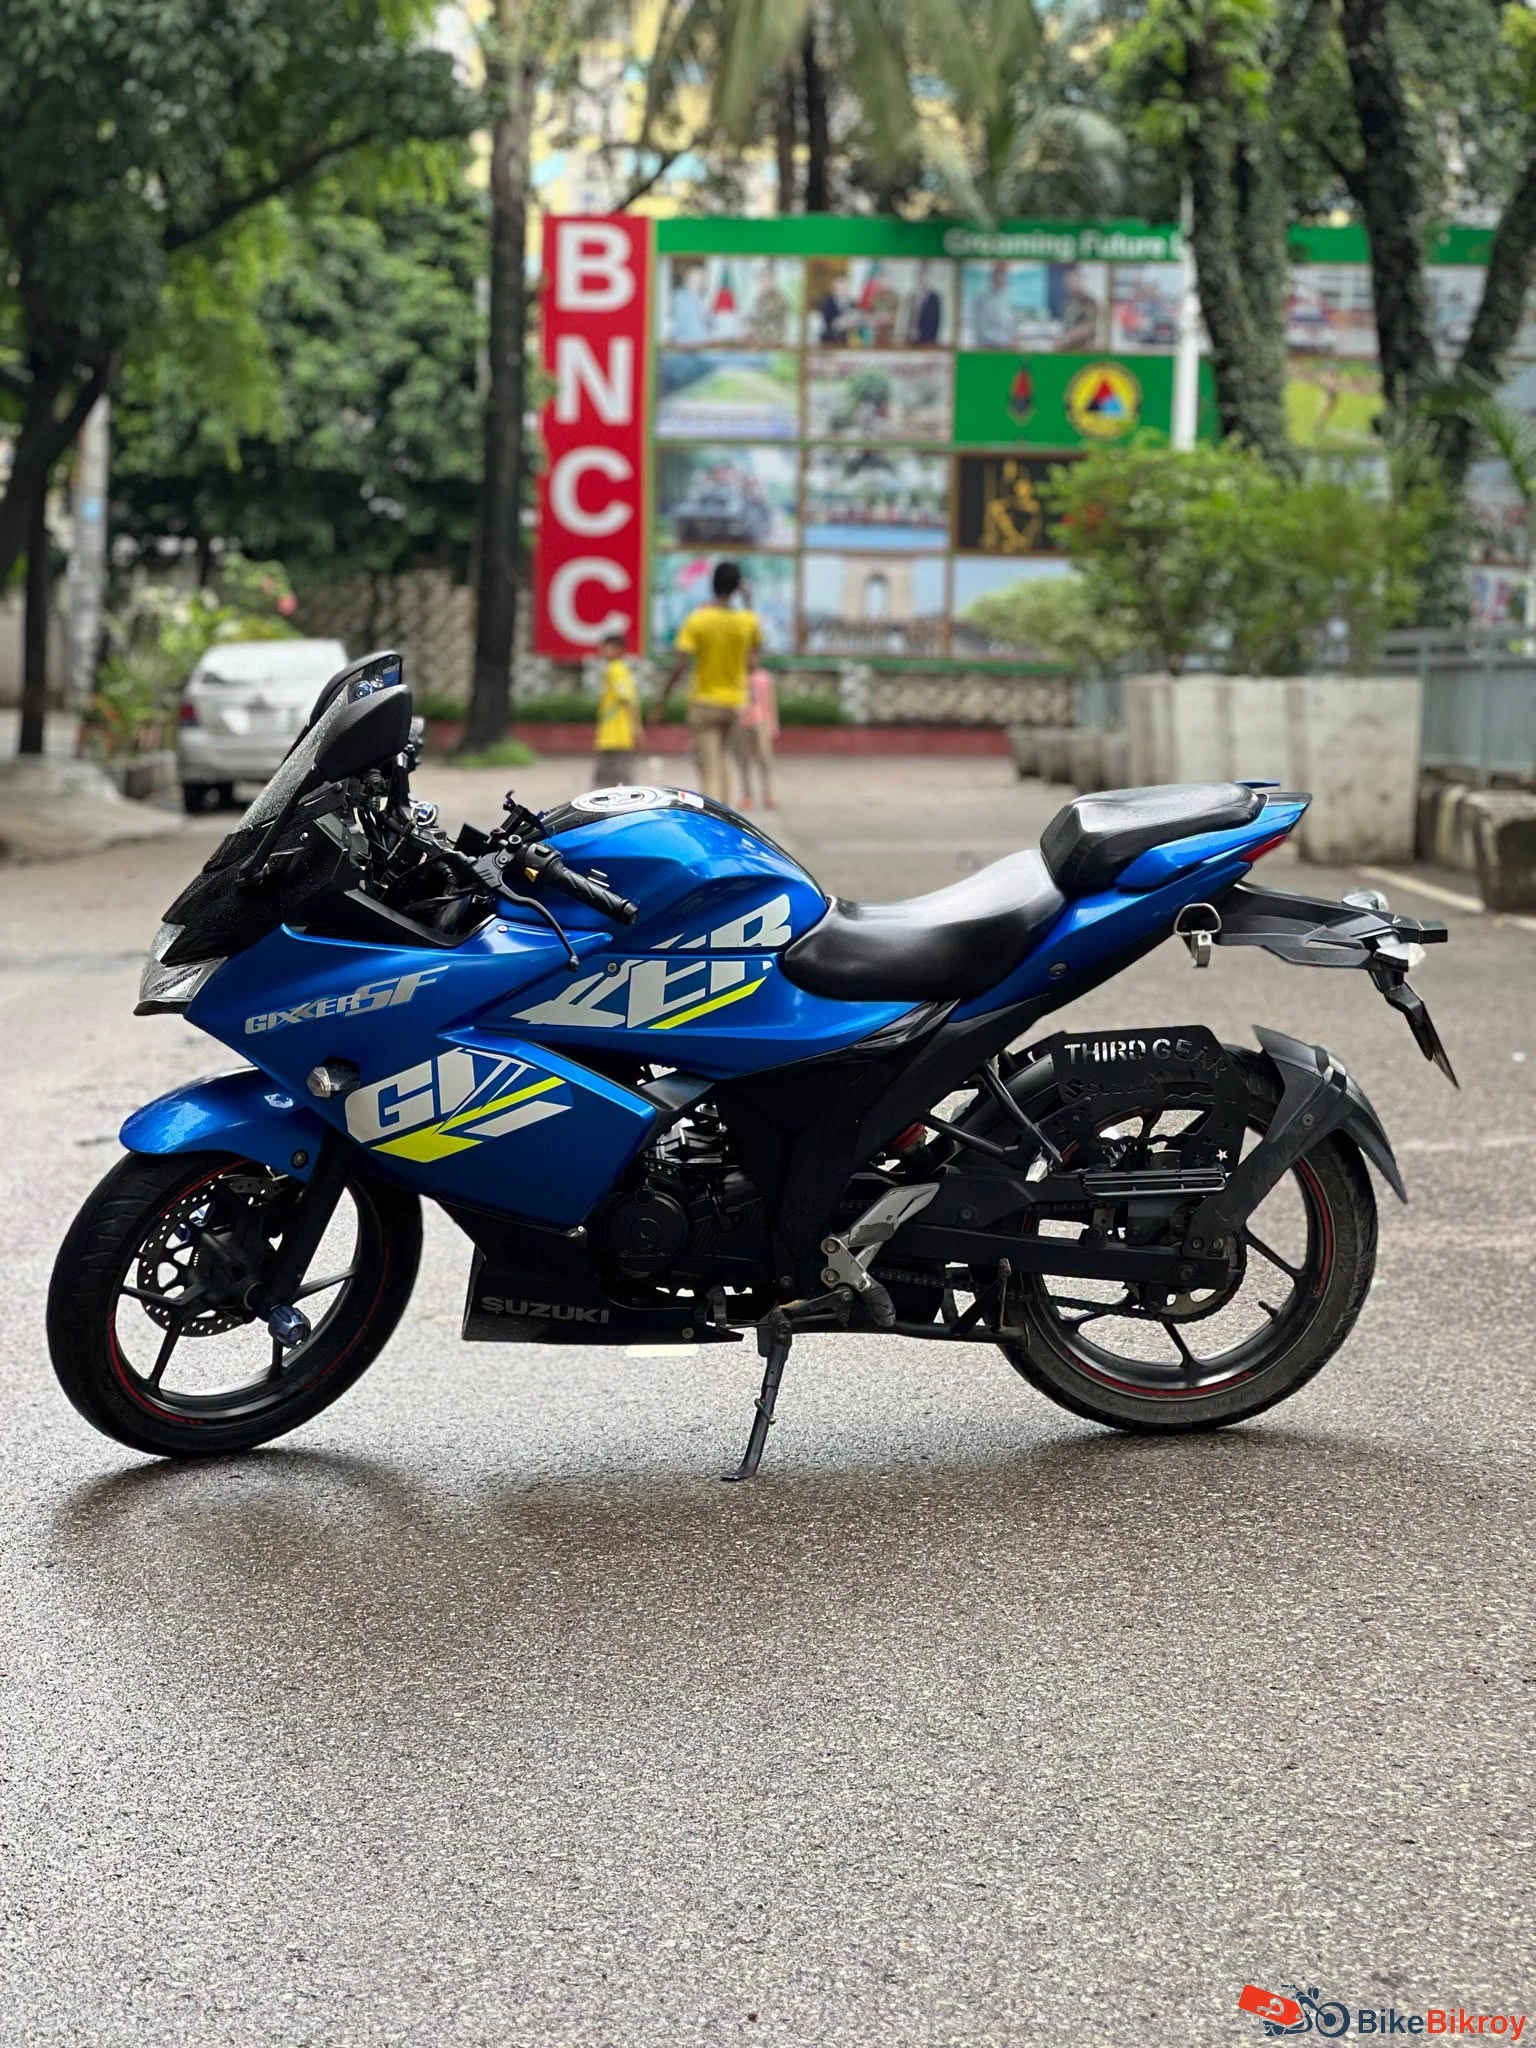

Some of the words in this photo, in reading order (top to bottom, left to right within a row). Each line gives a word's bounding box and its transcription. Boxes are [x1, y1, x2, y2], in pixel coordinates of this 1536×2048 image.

[1080, 228, 1167, 259] Future
[548, 223, 637, 645] BNCC
[1064, 1039, 1146, 1065] THIRD
[481, 1296, 610, 1324] SUZUKI
